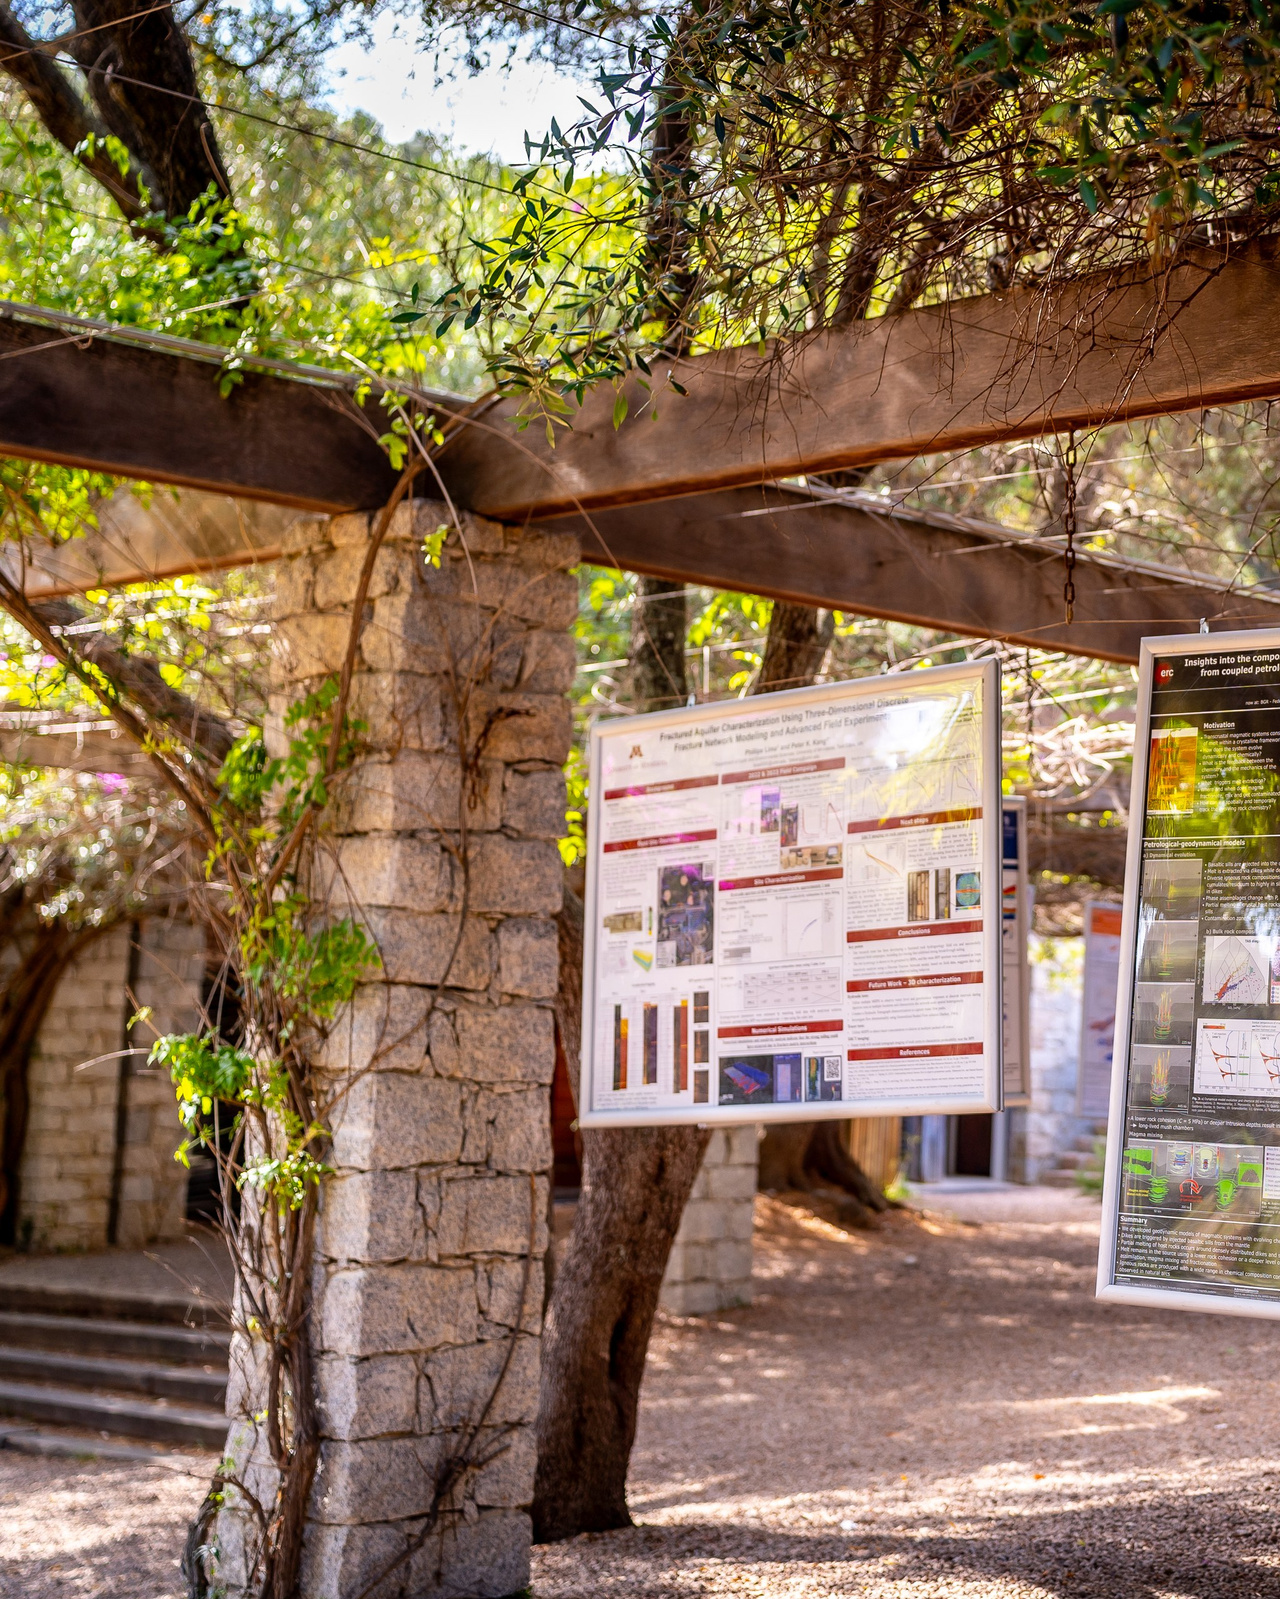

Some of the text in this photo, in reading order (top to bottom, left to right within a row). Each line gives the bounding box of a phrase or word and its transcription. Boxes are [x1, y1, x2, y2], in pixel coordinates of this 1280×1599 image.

[1184, 656, 1217, 667] Insights
[1218, 655, 1235, 664] into
[1236, 654, 1251, 663] the
[1160, 668, 1174, 677] erc
[1200, 668, 1220, 676] from
[1221, 664, 1253, 676] coupled
[659, 695, 910, 741] Fractured Aquifer Characterization Using Three-Dimensional Discrete
[1203, 721, 1235, 729] Motivation
[673, 741, 703, 751] Fracture
[704, 736, 733, 747] Network
[735, 731, 768, 742] Modeling
[769, 728, 784, 737] and
[784, 721, 822, 735] Advanced
[823, 718, 842, 729] Field
[764, 874, 805, 884] Characterization
[897, 927, 930, 936] Conclusions
[886, 979, 902, 987] Work
[907, 978, 916, 986] 3D
[916, 975, 961, 985] characterization
[750, 1024, 808, 1034] Numerical Simulations
[899, 1048, 930, 1056] References
[1119, 1215, 1148, 1225] Summary
